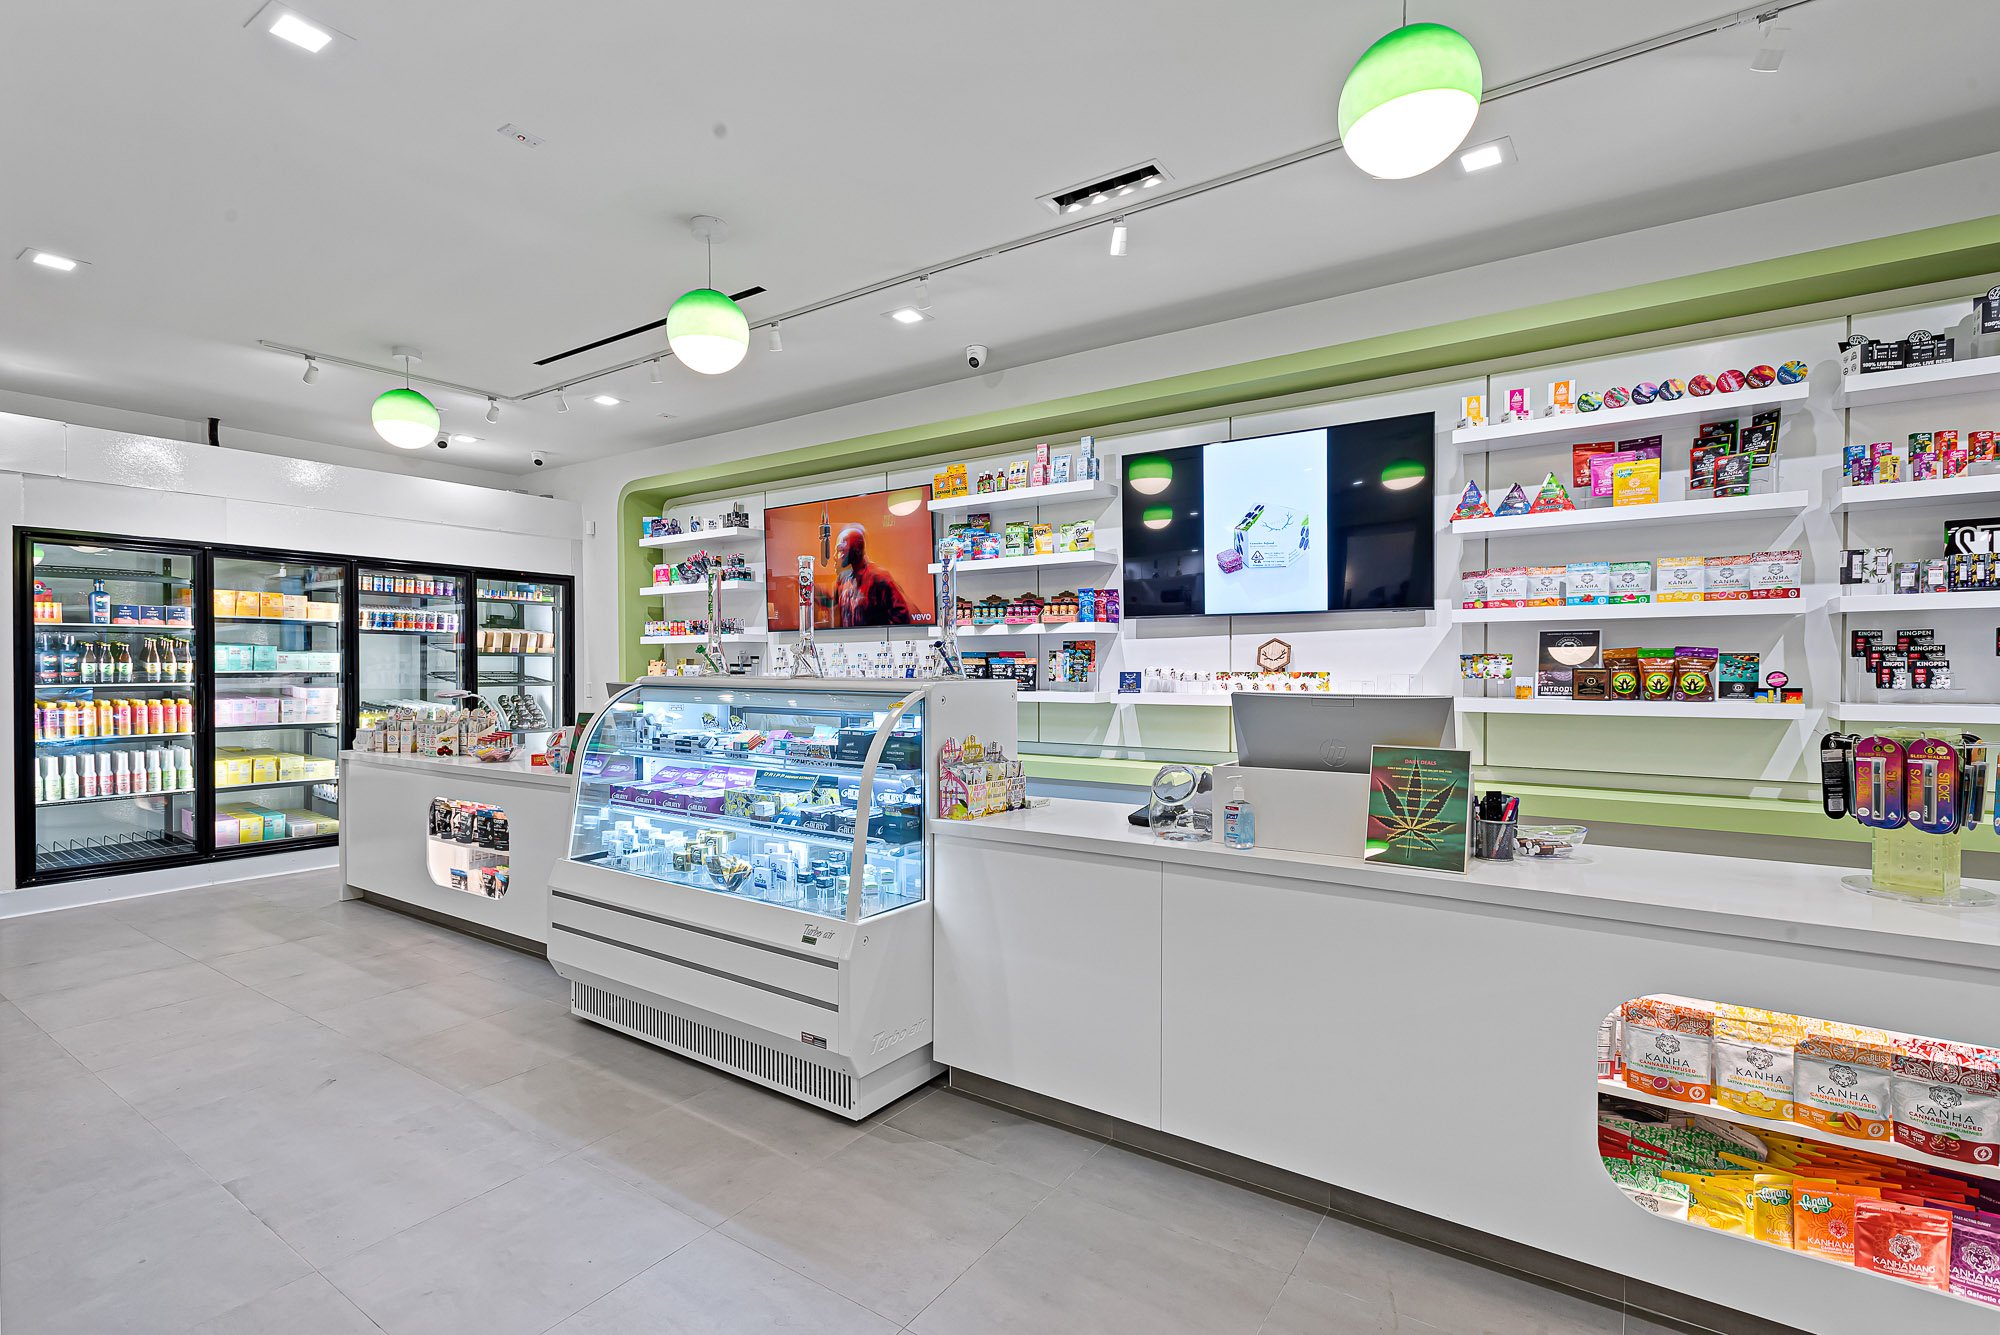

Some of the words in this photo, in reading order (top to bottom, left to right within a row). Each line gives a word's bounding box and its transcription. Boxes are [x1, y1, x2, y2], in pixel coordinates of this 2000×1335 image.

[841, 788, 859, 800] GALA
[803, 821, 829, 830] GALAXY
[837, 825, 855, 834] GALA
[804, 924, 823, 937] Turbo
[822, 930, 835, 939] air
[1690, 1020, 1707, 1028] BLISS
[870, 1030, 907, 1055] Turbo
[907, 1018, 927, 1038] air
[1645, 1052, 1690, 1067] KANHA
[1870, 1053, 1889, 1063] BLISS
[1639, 1059, 1669, 1070] CANNABIS
[1670, 1064, 1696, 1074] INFUSED
[1729, 1074, 1762, 1085] CANNABIS
[1762, 1080, 1792, 1090] INFUSED
[1735, 1067, 1784, 1084] KANHA
[1975, 1074, 1997, 1085] BLISS
[1743, 1082, 1770, 1092] PINEAPPLE
[1817, 1084, 1869, 1103] KANHA
[1809, 1092, 1844, 1104] CANNABIS
[1846, 1098, 1877, 1110] INFUSED
[1810, 1097, 1828, 1105] INDICA
[1829, 1101, 1850, 1110] MANGO
[1851, 1106, 1877, 1115] GUMMIES
[1908, 1111, 1948, 1126] CANNABIS
[1950, 1120, 1983, 1132] INFUSED
[1916, 1104, 1975, 1124] KANHA
[1910, 1116, 1929, 1126] SATIVA
[1930, 1121, 1953, 1131] CHERRY
[1954, 1127, 1983, 1137] GUMMIES
[1910, 1130, 1926, 1140] 100mg
[1756, 1187, 1791, 1205] Vegan
[1798, 1194, 1833, 1213] Vegan
[1766, 1228, 1792, 1238] KANH
[1807, 1236, 1840, 1247] KANHA
[1872, 1256, 1908, 1269] KANHA
[1909, 1264, 1936, 1273] NANO
[1966, 1287, 1996, 1303] Galactic
